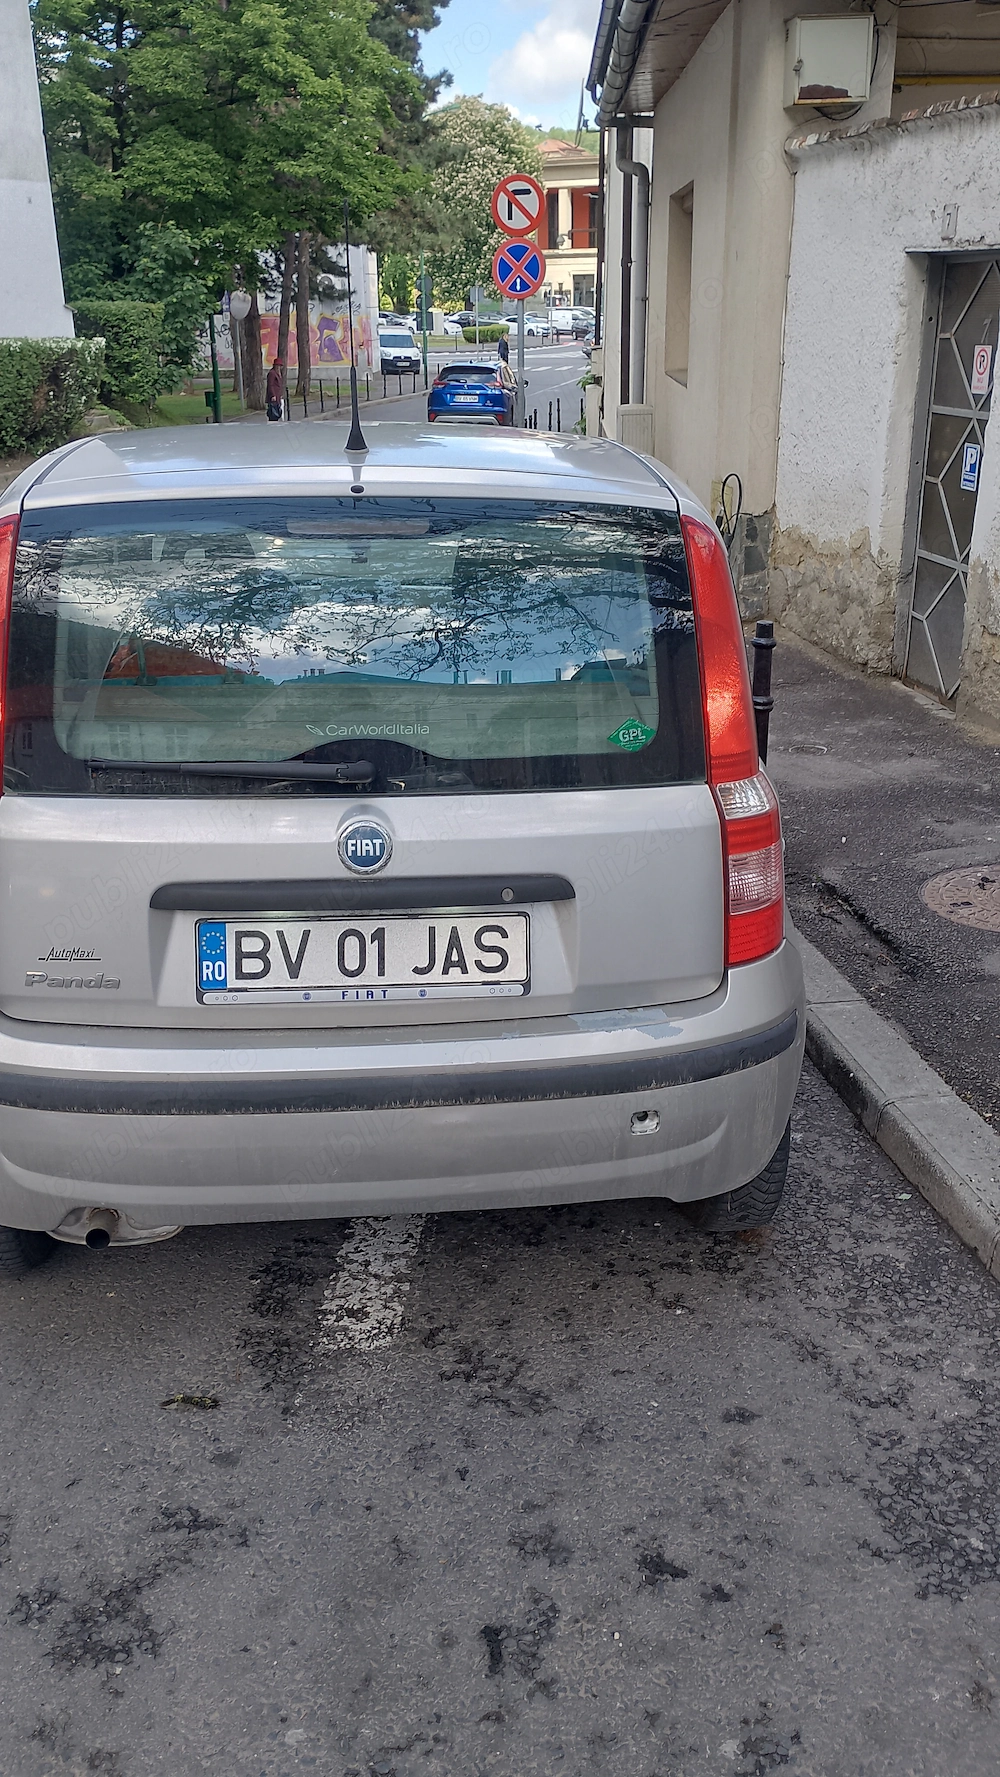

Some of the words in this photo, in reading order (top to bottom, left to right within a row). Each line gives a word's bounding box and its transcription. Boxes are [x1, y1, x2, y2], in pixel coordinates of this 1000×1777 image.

[964, 447, 978, 472] P
[326, 723, 430, 736] CarWorldItalia
[618, 727, 646, 742] GPL
[347, 838, 383, 857] FIAT
[45, 946, 96, 962] AutoMaxi
[234, 928, 311, 980] BV
[337, 926, 386, 978] 01
[411, 924, 510, 976] JAS
[202, 960, 226, 981] RO
[24, 971, 121, 990] Panda
[341, 989, 389, 1000] FIAT
